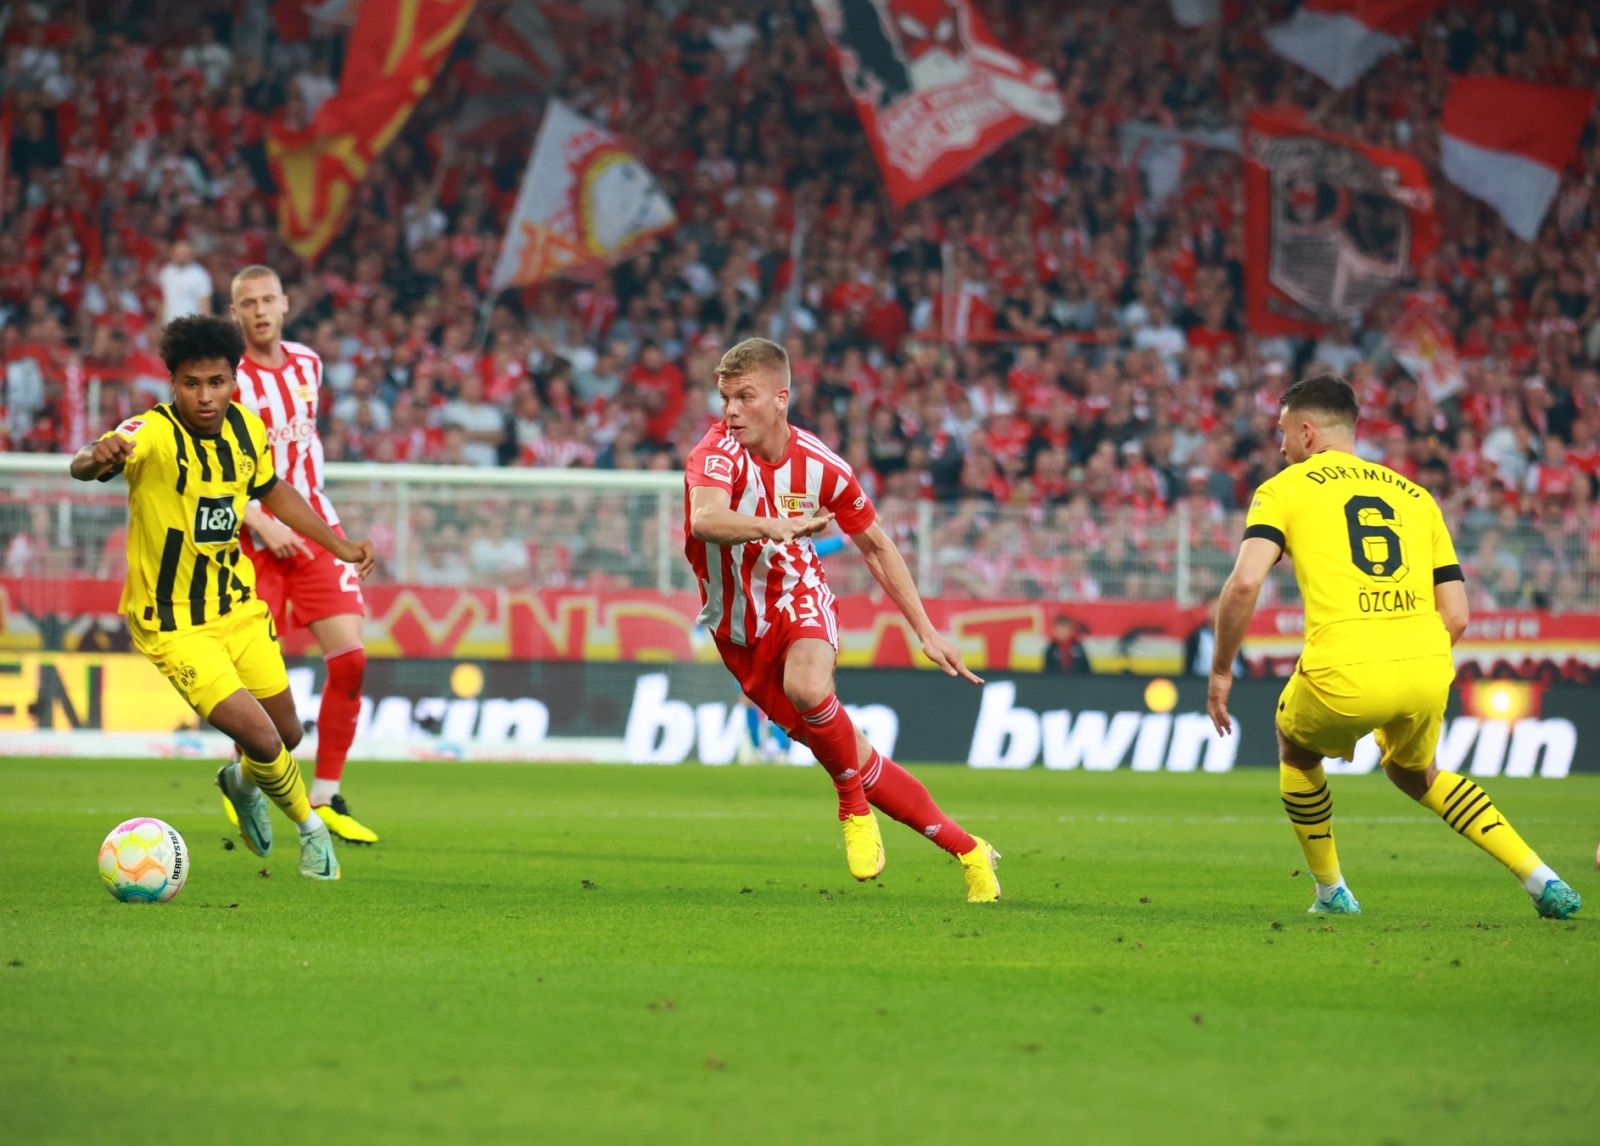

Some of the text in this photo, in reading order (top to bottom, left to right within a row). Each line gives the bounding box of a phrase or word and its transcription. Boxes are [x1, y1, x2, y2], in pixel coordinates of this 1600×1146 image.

[200, 506, 235, 531] 1&1
[1343, 495, 1409, 583] 6
[774, 592, 819, 623] 13
[1359, 587, 1417, 613] ÖZCAN
[623, 672, 899, 765] bwn
[967, 679, 1242, 772] bwin
[167, 830, 183, 881] DERBYSTAR
